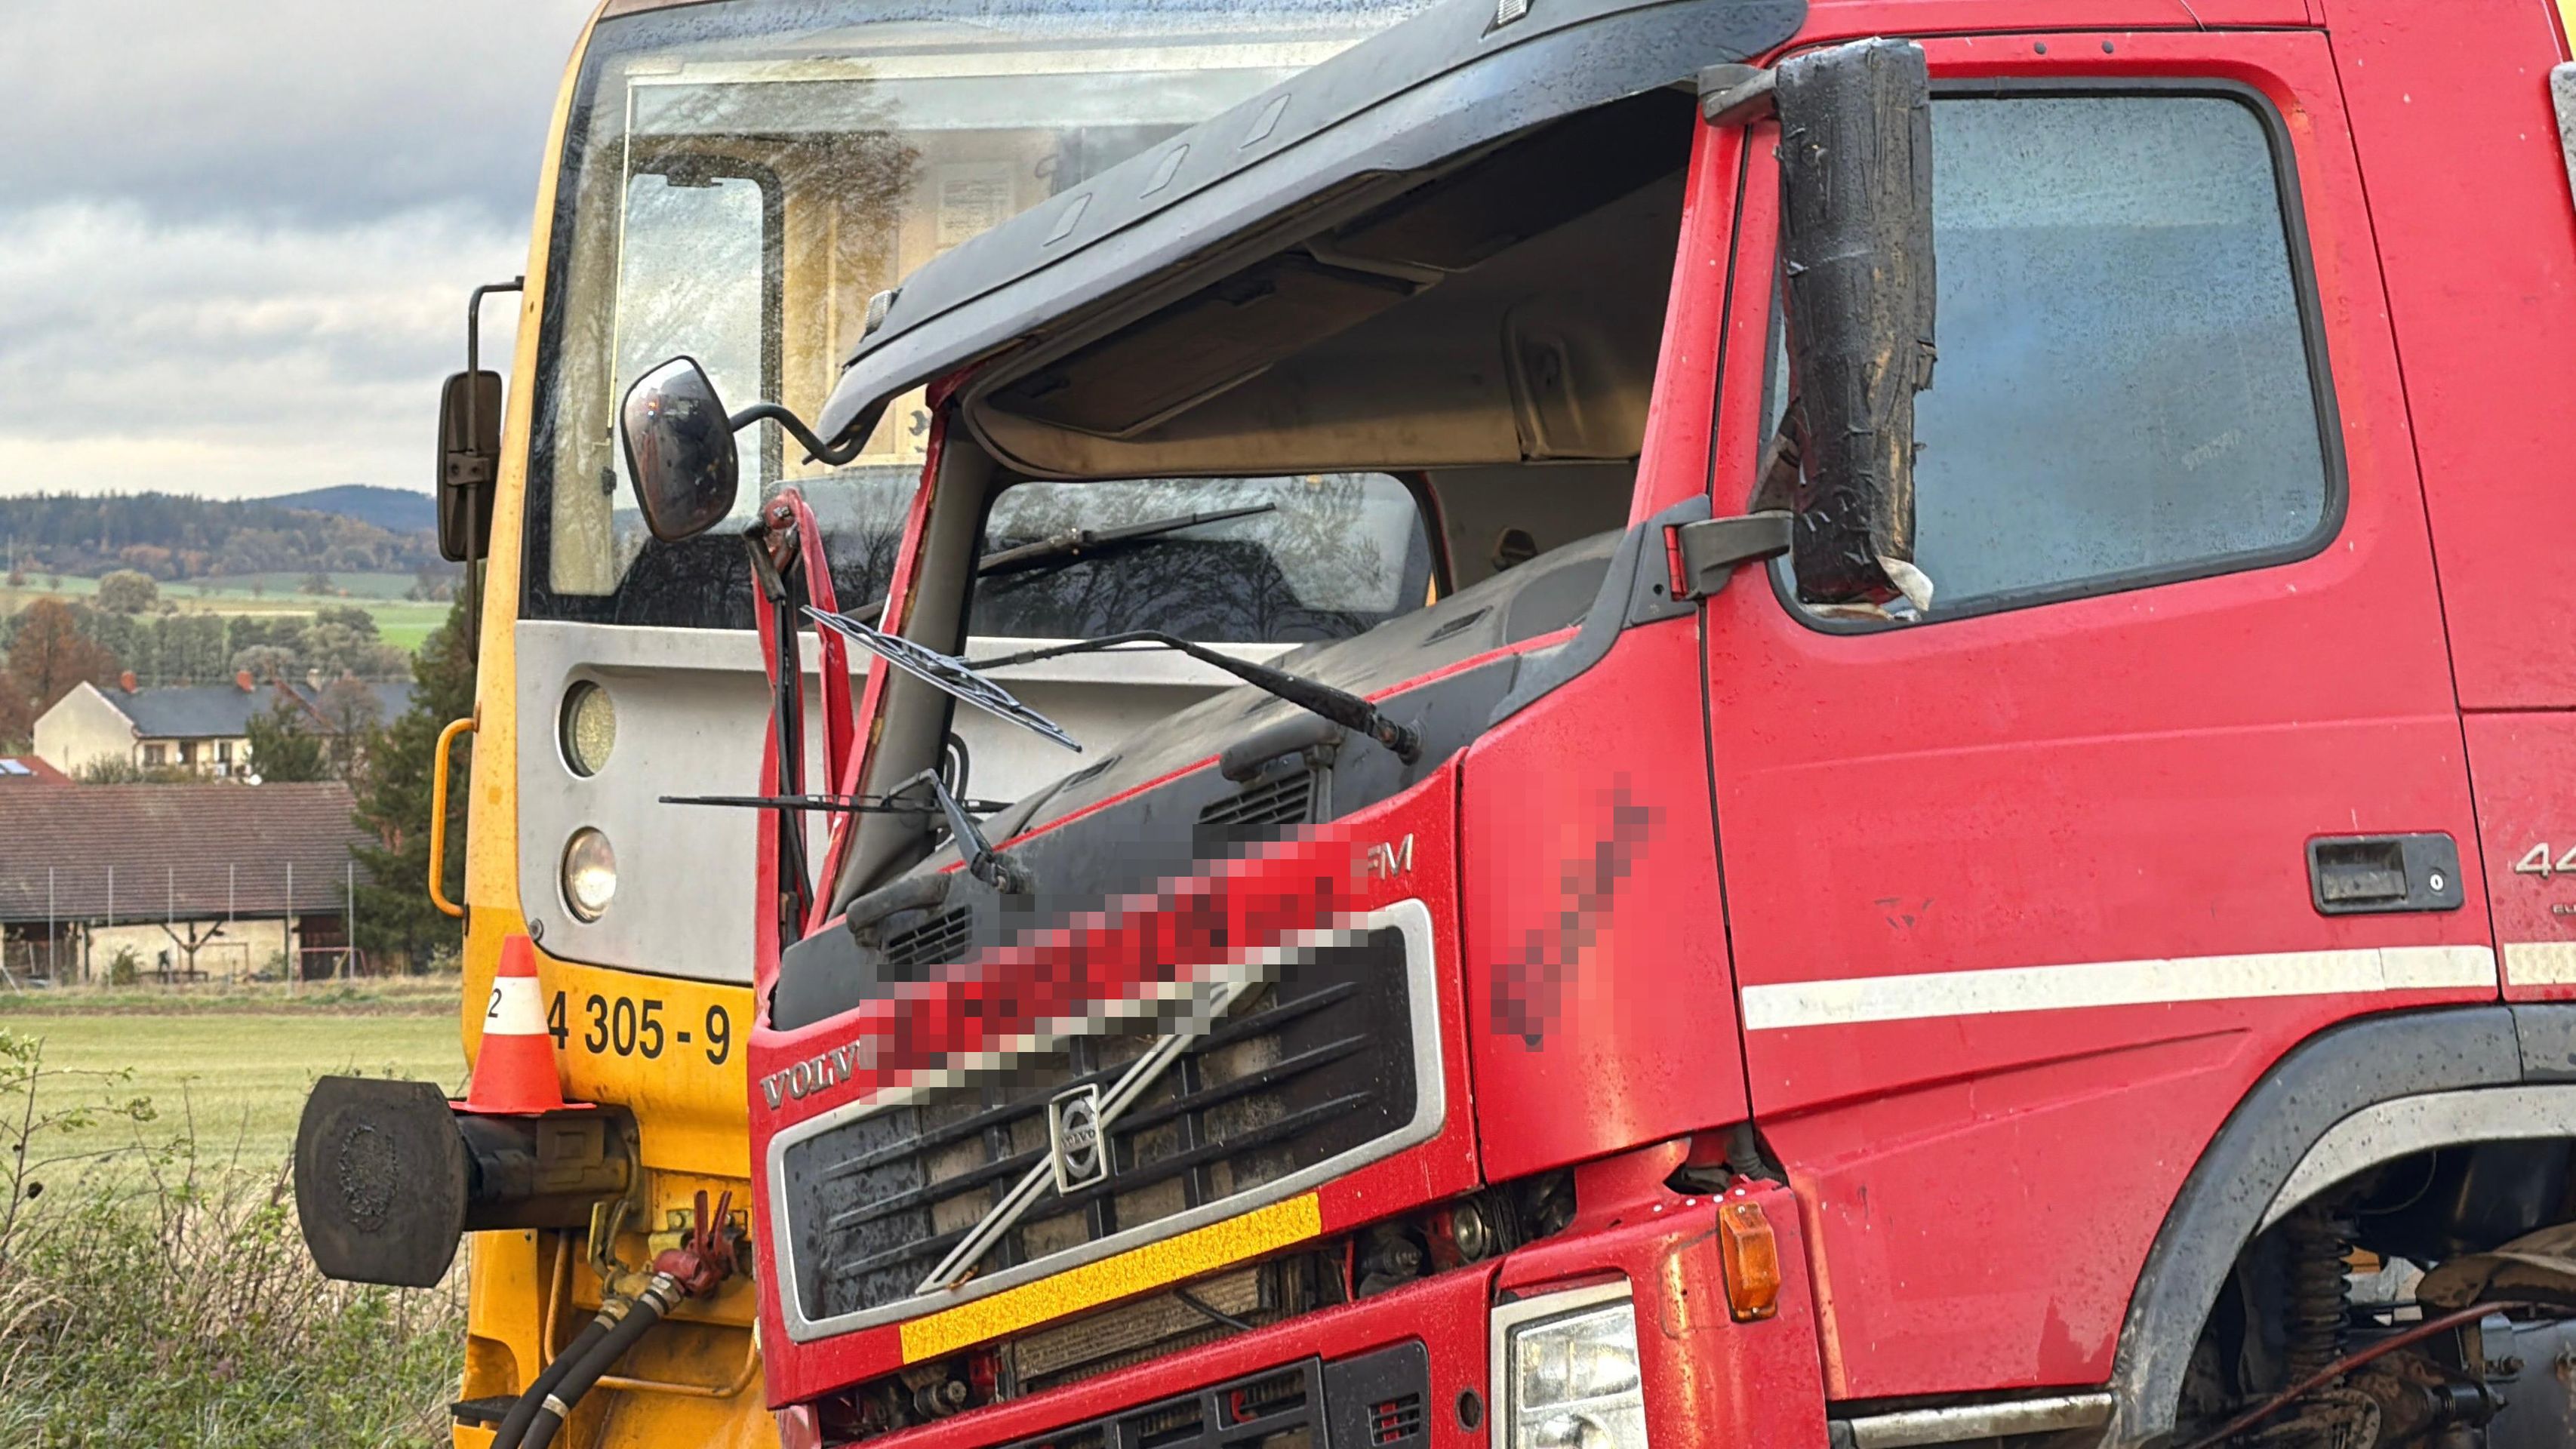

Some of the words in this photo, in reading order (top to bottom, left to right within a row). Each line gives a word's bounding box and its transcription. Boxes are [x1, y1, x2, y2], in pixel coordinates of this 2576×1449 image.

[488, 987, 502, 1018] 2
[584, 993, 664, 1060] 305
[759, 1038, 877, 1110] VOLV
[1060, 1128, 1096, 1148] VOLVO
